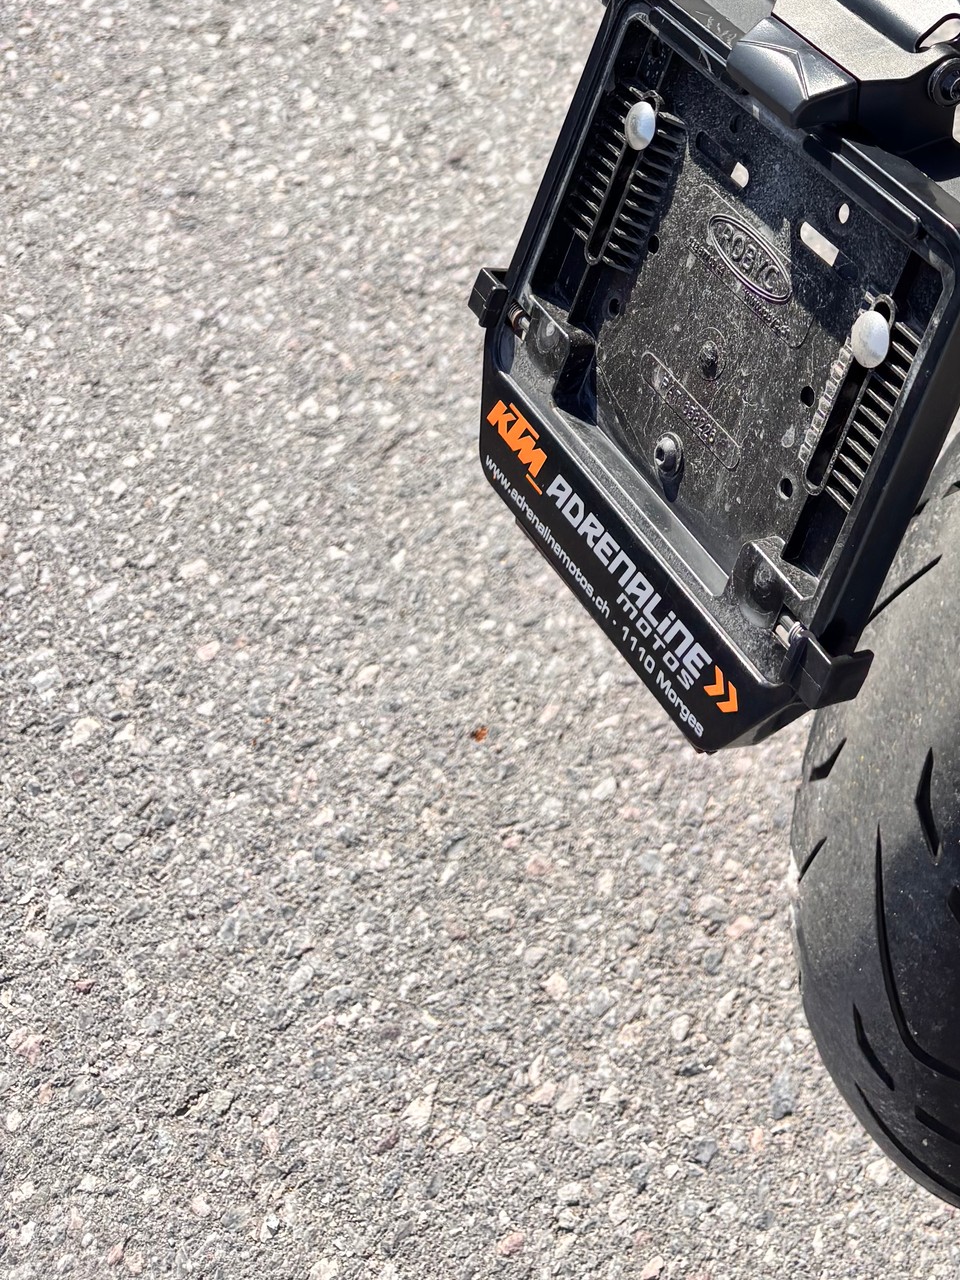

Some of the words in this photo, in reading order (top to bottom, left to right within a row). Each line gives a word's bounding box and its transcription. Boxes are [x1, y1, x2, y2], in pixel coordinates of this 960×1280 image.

[712, 220, 781, 291] ROBYC
[487, 401, 548, 478] KTM
[621, 626, 656, 674] 1110
[655, 669, 704, 737] Morges
